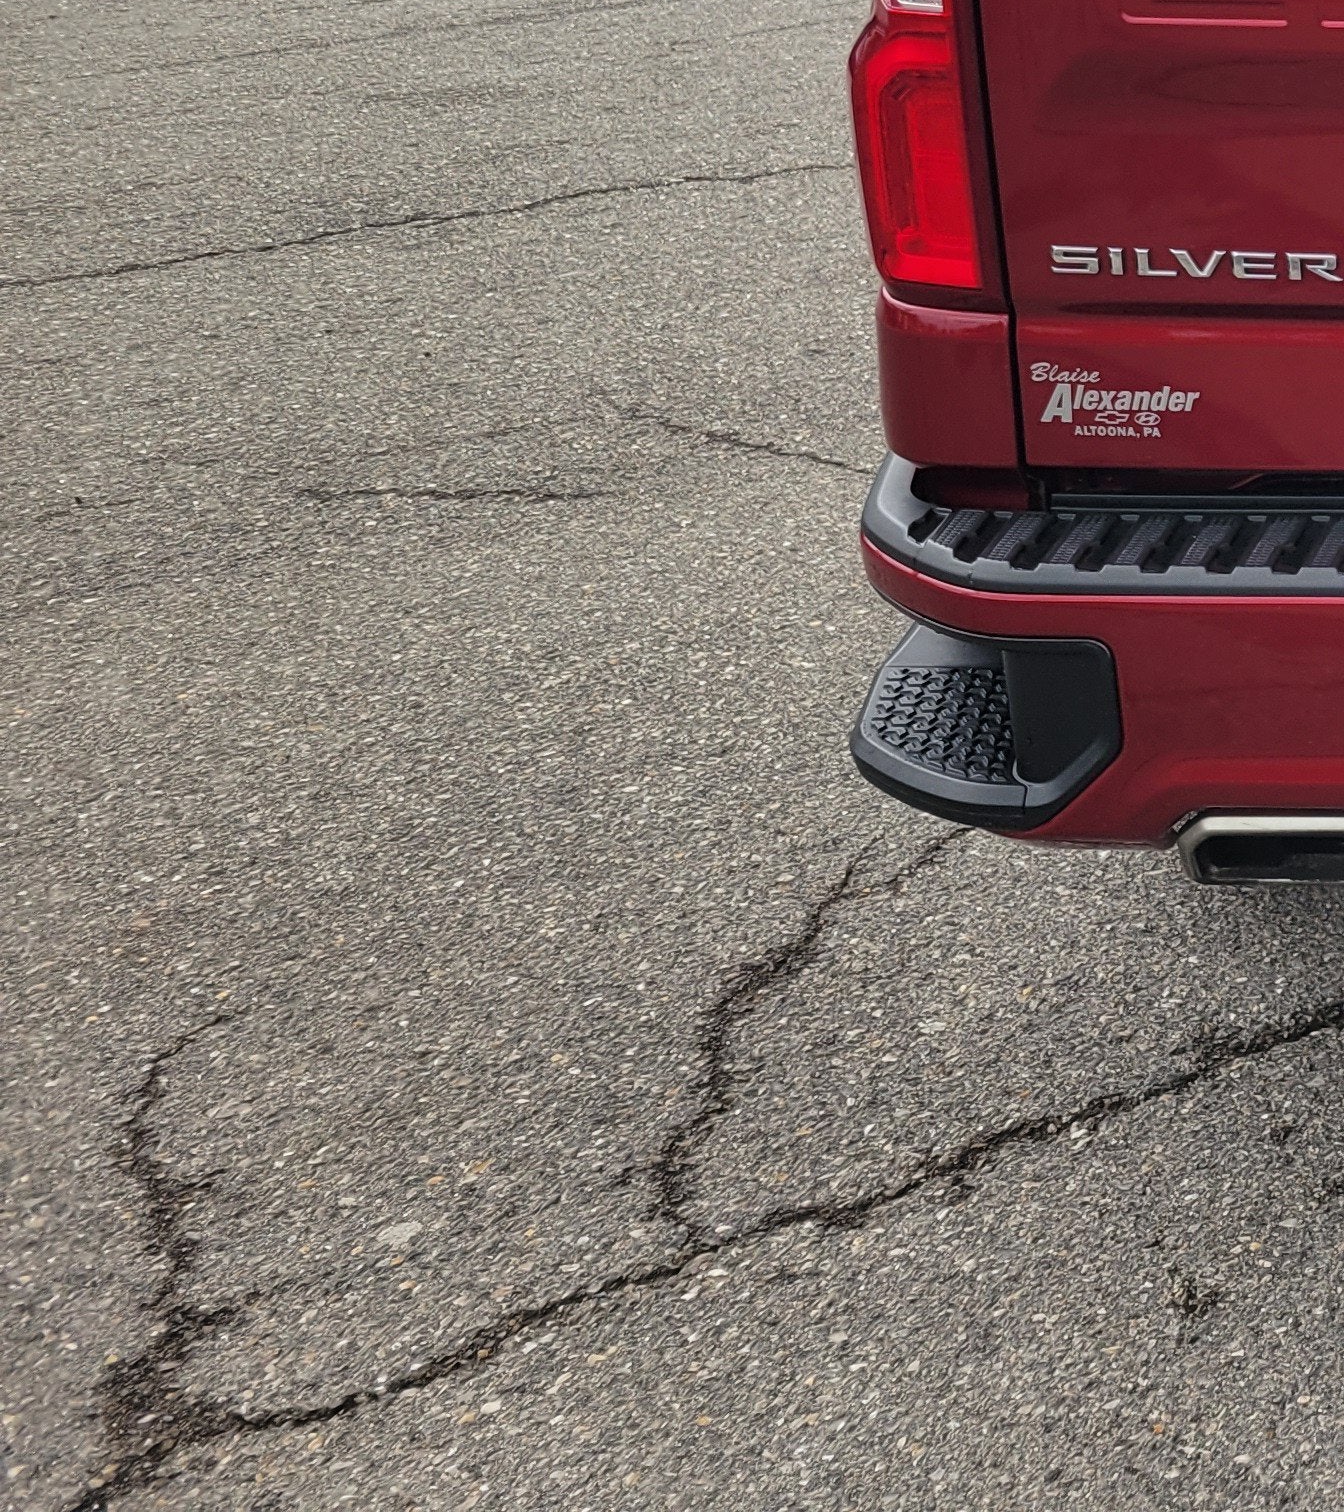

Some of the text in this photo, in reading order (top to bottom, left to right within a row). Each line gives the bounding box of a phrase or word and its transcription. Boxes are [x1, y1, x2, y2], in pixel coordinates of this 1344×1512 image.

[1029, 361, 1101, 383] Blaise
[1040, 383, 1200, 423] Alexander
[1074, 425, 1162, 438] ALTOONA, PA
